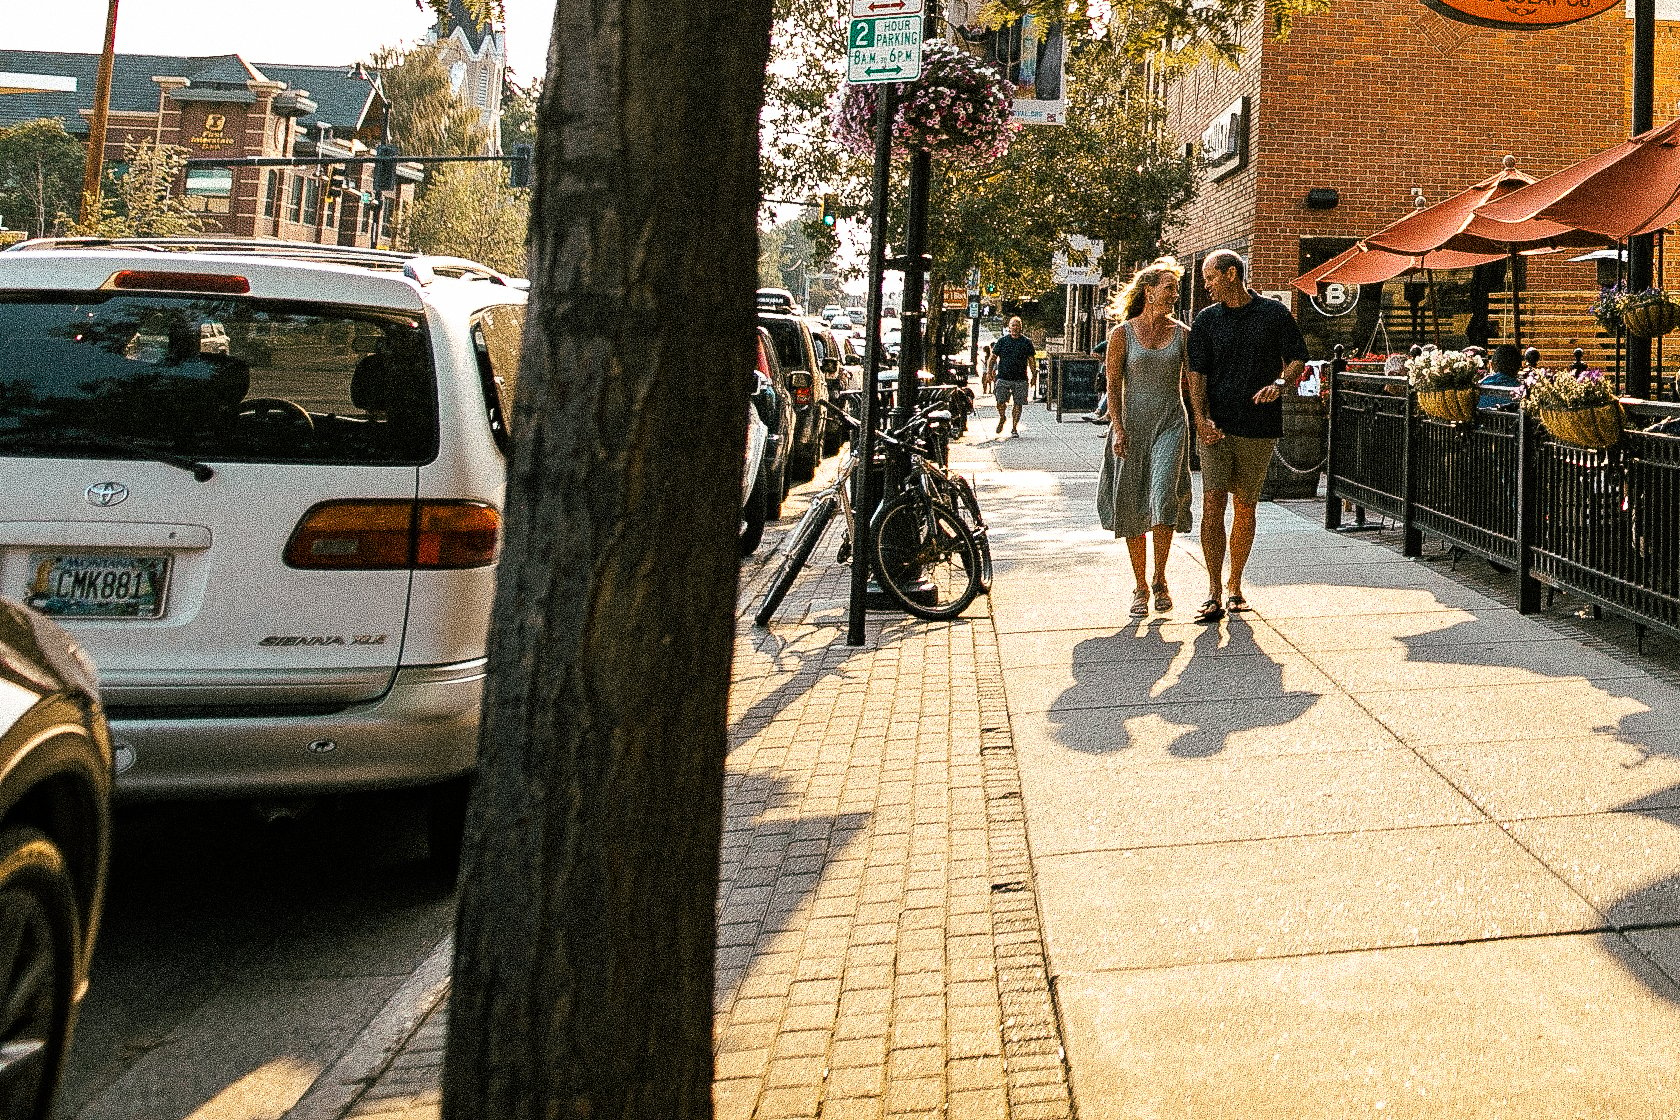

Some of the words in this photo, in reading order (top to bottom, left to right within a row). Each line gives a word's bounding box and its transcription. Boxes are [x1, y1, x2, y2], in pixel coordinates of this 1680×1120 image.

[856, 21, 868, 46] 2
[884, 20, 910, 31] HOUR
[877, 31, 917, 47] PARKING
[1326, 283, 1346, 304] B
